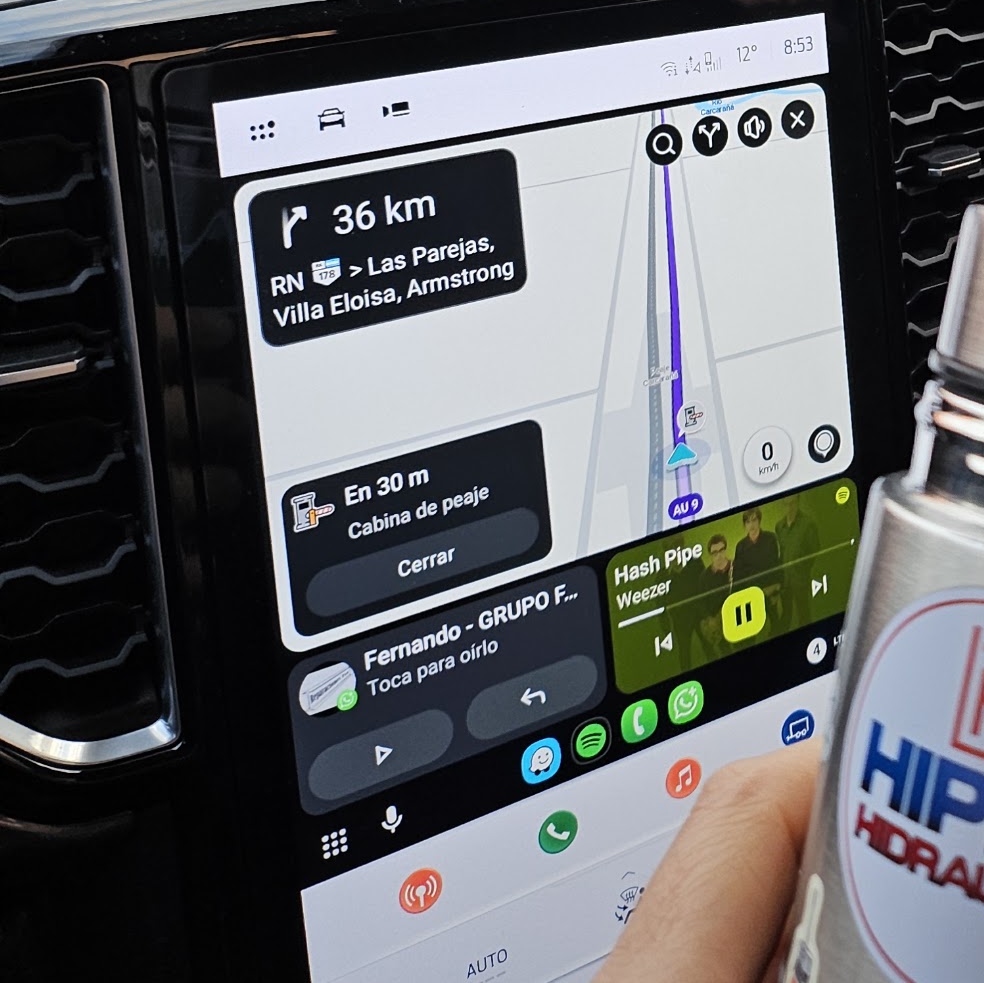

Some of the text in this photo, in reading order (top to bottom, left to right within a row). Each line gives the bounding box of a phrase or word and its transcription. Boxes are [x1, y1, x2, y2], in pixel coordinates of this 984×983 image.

[737, 44, 758, 63] 12°
[784, 36, 813, 55] 8:53
[332, 193, 436, 235] 36 km
[270, 271, 304, 297] RN
[318, 269, 336, 281] 178
[366, 253, 407, 276] Las
[411, 236, 495, 267] Parejas,
[272, 261, 515, 328] Villa Eloisa, Armstrong
[761, 441, 774, 461] 0
[758, 461, 779, 476] km/h
[344, 468, 430, 506] En 30 m
[348, 485, 490, 539] Cabina de peaje
[672, 498, 699, 517] AU 9
[397, 547, 456, 577] Cerrar
[614, 543, 703, 587] Hash Pipe
[616, 578, 671, 610] Weezer
[363, 623, 462, 671] Fernando
[478, 595, 550, 631] GRUPO
[813, 642, 821, 656] 4
[366, 671, 412, 696] Toca
[416, 656, 456, 684] para
[459, 637, 499, 663] oírlo
[466, 948, 508, 979] AUTO
